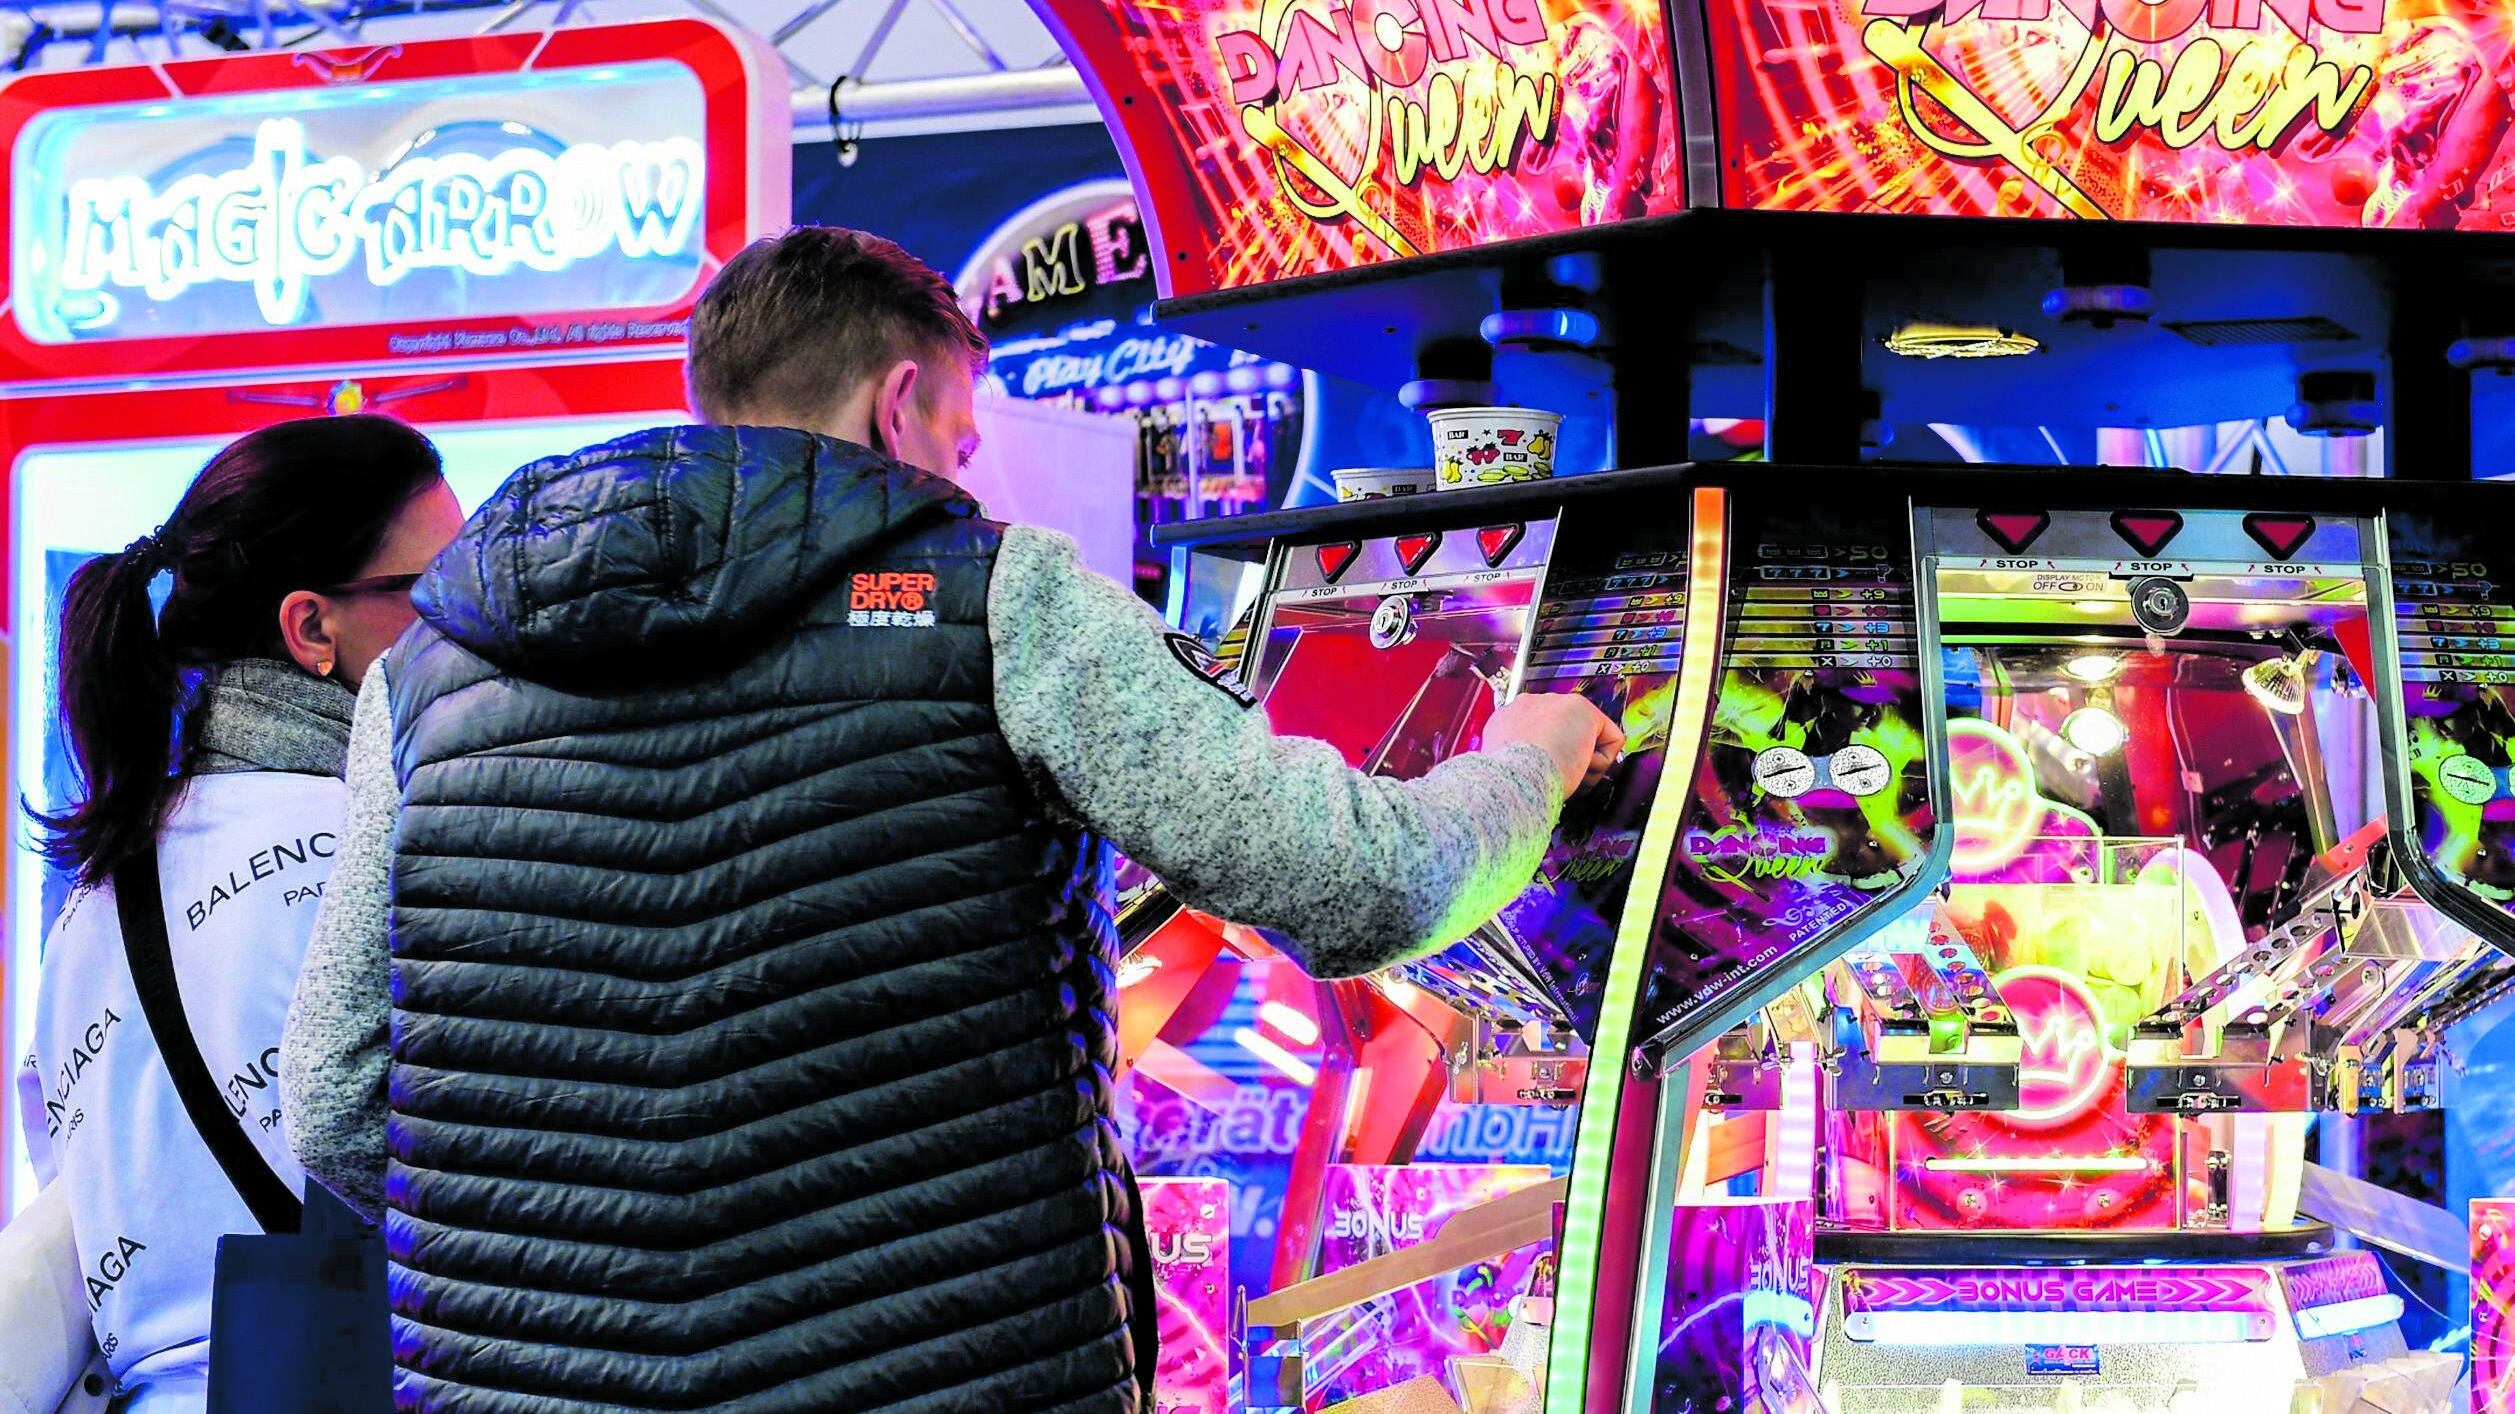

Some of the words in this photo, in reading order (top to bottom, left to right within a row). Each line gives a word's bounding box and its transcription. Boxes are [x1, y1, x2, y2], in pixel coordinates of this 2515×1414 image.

[1216, 0, 1548, 104] DANCING
[1023, 353, 1104, 394] Play
[1447, 431, 1467, 440] BAR
[1504, 453, 1526, 462] BAR
[1850, 546, 1889, 560] 50
[1996, 560, 2039, 569] STOP
[2130, 562, 2173, 571] STOP
[2263, 565, 2306, 574] STOP
[2451, 562, 2487, 580] 50
[852, 572, 936, 593] SUPER
[1472, 572, 1502, 583] STOP
[1390, 579, 1418, 590] STOP
[2033, 581, 2058, 591] OFF
[2086, 582, 2104, 591] ON
[1311, 587, 1338, 598] STOP
[1860, 588, 1886, 600] +9
[1863, 622, 1890, 634] +3
[1866, 640, 1889, 651] +1
[186, 832, 337, 932] BALENC
[1788, 902, 1848, 942] PATENTED
[1655, 944, 1779, 1025] www.vdw-int.com
[1334, 1209, 1424, 1241] BONUS
[1749, 1252, 1809, 1293] BONUS
[1958, 1280, 2066, 1302] BONUS
[2072, 1280, 2159, 1302] GAME
